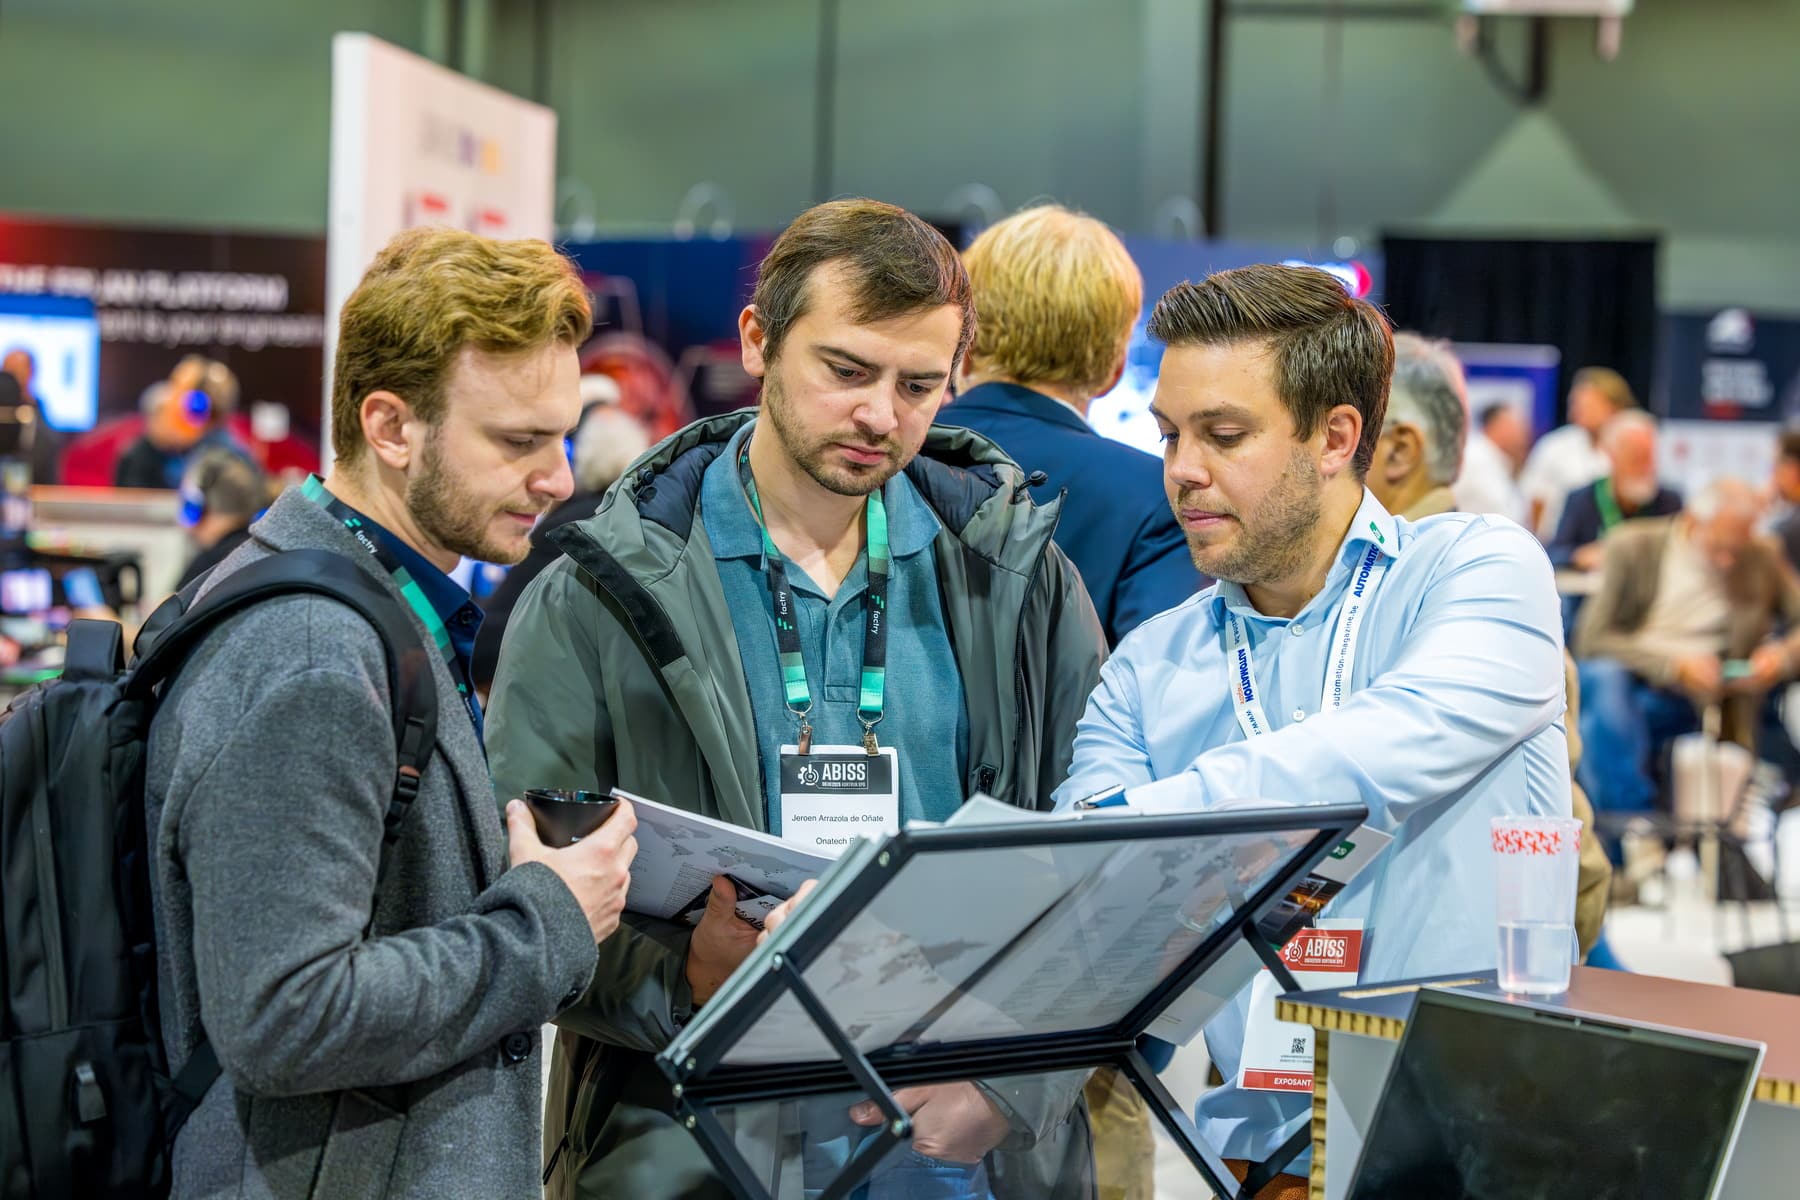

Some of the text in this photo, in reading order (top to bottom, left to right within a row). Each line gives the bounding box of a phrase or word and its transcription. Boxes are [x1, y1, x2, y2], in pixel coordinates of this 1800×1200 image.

[355, 530, 378, 554] factry
[1353, 543, 1379, 598] AUTOMATIO
[779, 590, 787, 615] factry
[870, 609, 881, 635] factry
[1237, 648, 1255, 703] AUTOMATION
[822, 763, 866, 781] ABISS
[791, 814, 884, 822] Jeroen Arrazola de Oñate
[815, 836, 848, 845] Onatech
[1305, 938, 1346, 958] ABISS
[1273, 1077, 1312, 1087] EXPOSANT
